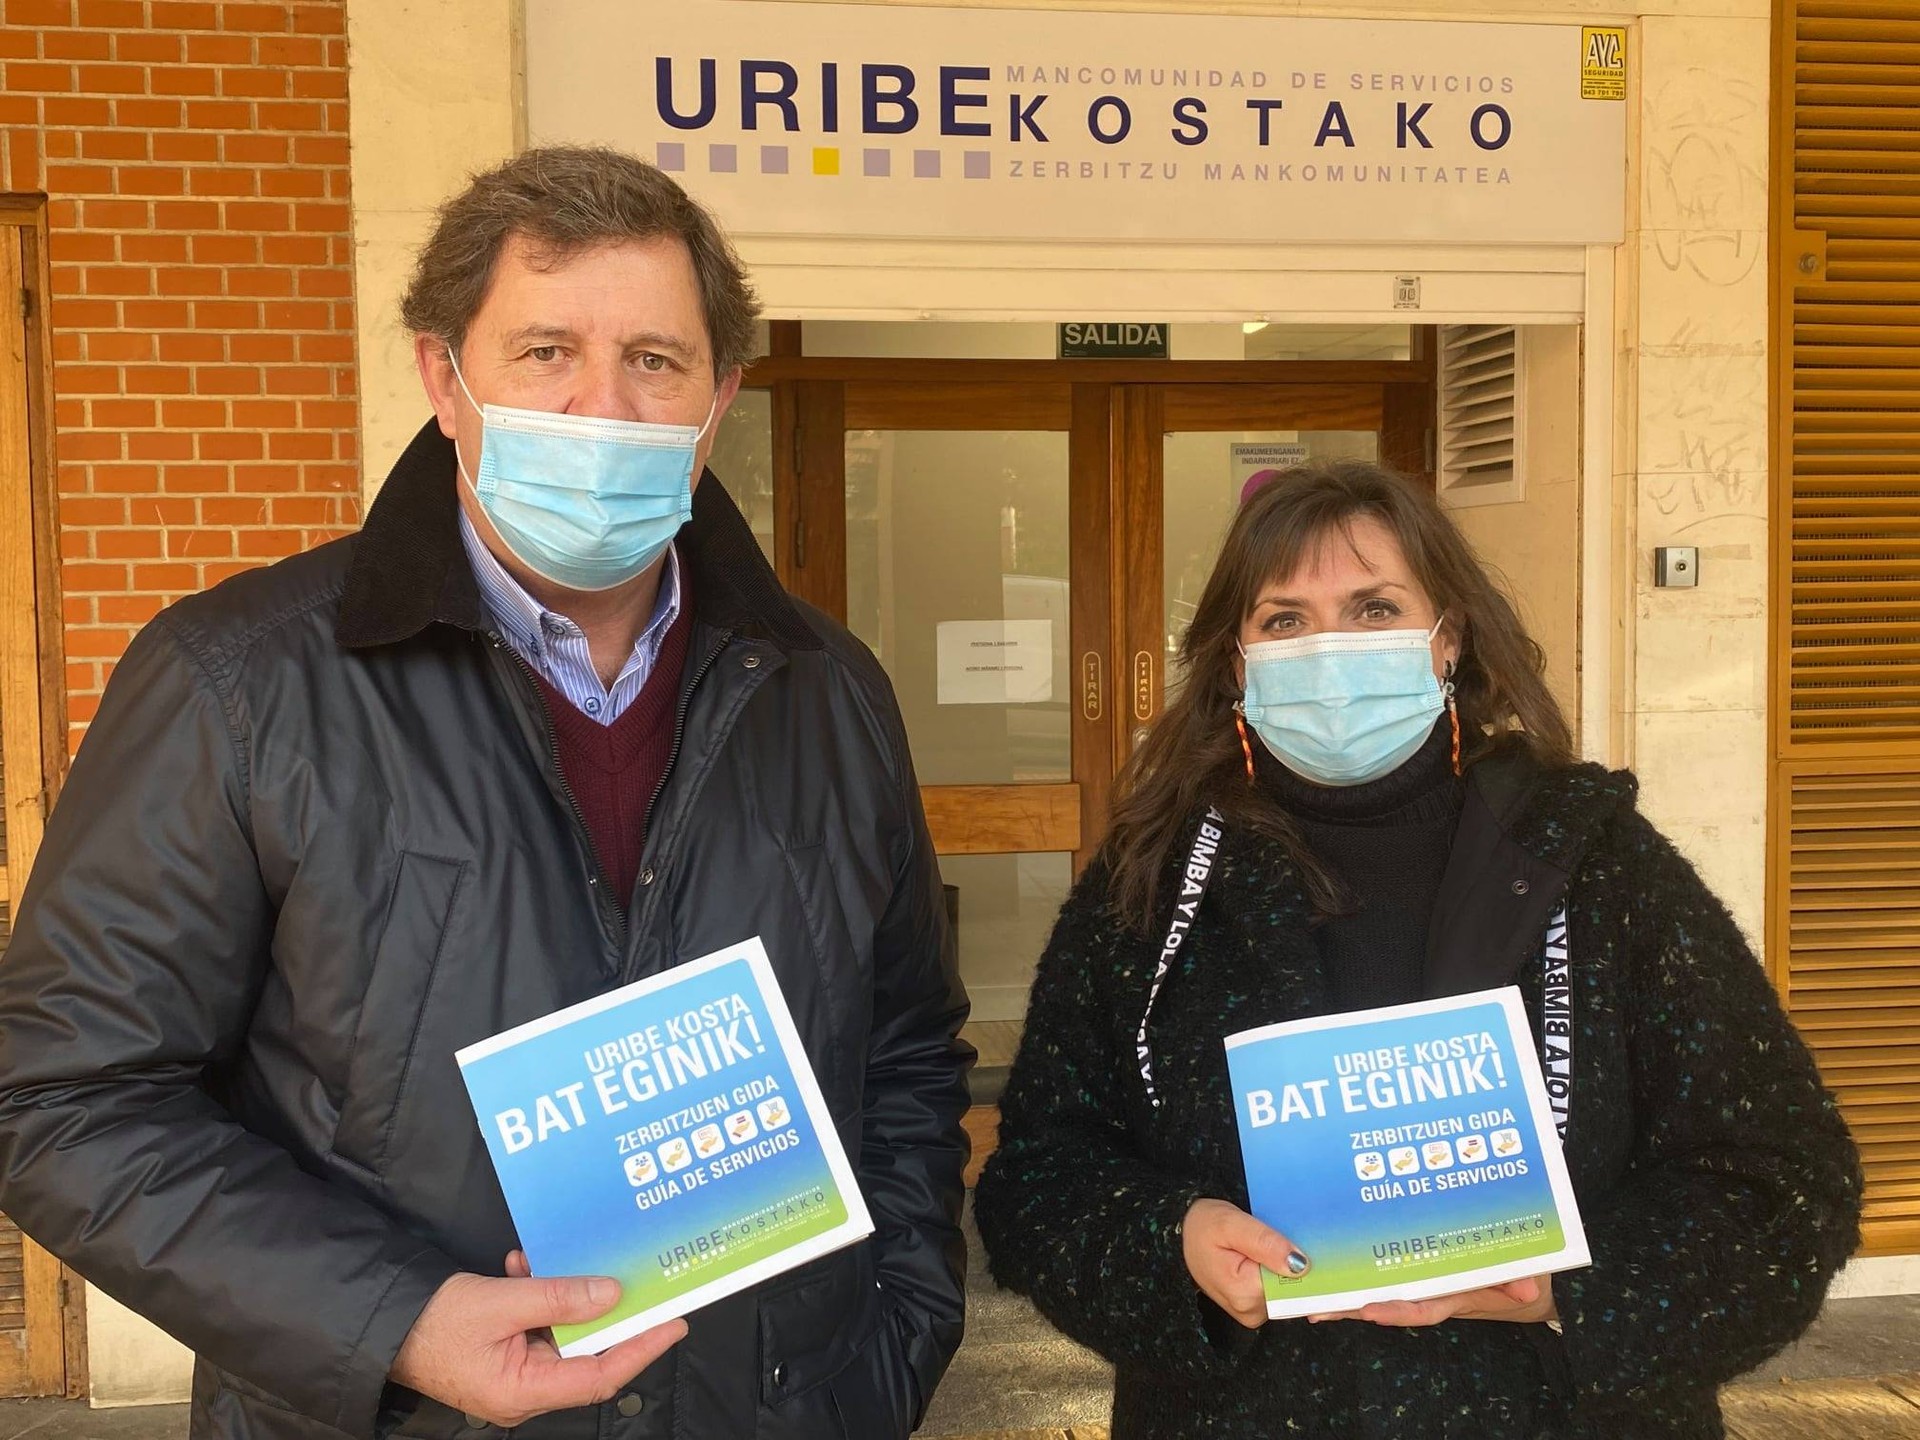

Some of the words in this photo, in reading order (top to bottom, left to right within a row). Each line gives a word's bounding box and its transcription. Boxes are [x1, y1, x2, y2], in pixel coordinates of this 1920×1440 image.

[1006, 65, 1266, 88] MANCOMUNIDAD
[1291, 71, 1327, 89] DE
[1350, 73, 1514, 94] SERVICIOS
[1584, 69, 1624, 77] SEGURIDAD
[656, 56, 992, 137] URIBE
[1009, 93, 1512, 151] KOSTAKO
[1009, 160, 1178, 180] ZERBITZU
[1204, 162, 1512, 184] MANKOMUNITATEA
[1064, 323, 1163, 345] SALIDA
[1087, 663, 1098, 709] TIRAR
[1139, 662, 1149, 710] TIRATU
[1181, 822, 1223, 896] BIMBA
[1177, 901, 1198, 920] Y
[584, 1024, 662, 1075] URIBE
[668, 992, 751, 1048] KOSTA
[1333, 1045, 1411, 1077] URIBE
[1413, 1031, 1499, 1064] KOSTA
[495, 1082, 590, 1155] BAT
[592, 1015, 767, 1116] EGINIK!
[1245, 1079, 1330, 1128] BAT
[1337, 1051, 1508, 1114] EGINIK!
[615, 1092, 731, 1154] ZERBITZUEN
[732, 1074, 780, 1108] GIDA
[1349, 1117, 1465, 1151] ZERBITZUEN
[1468, 1107, 1516, 1130] GIDA
[634, 1177, 682, 1211] GUÍA
[684, 1166, 709, 1192] DE
[711, 1130, 801, 1182] SERVICIOS
[1360, 1178, 1406, 1203] GUÍA
[1410, 1177, 1433, 1196] DE
[1436, 1158, 1529, 1191] SERVICIOS
[657, 1229, 724, 1269] URIBE
[725, 1191, 825, 1242] KOSTAKO
[1372, 1234, 1438, 1260] URIBE
[1440, 1218, 1545, 1248] KOSTAKO
